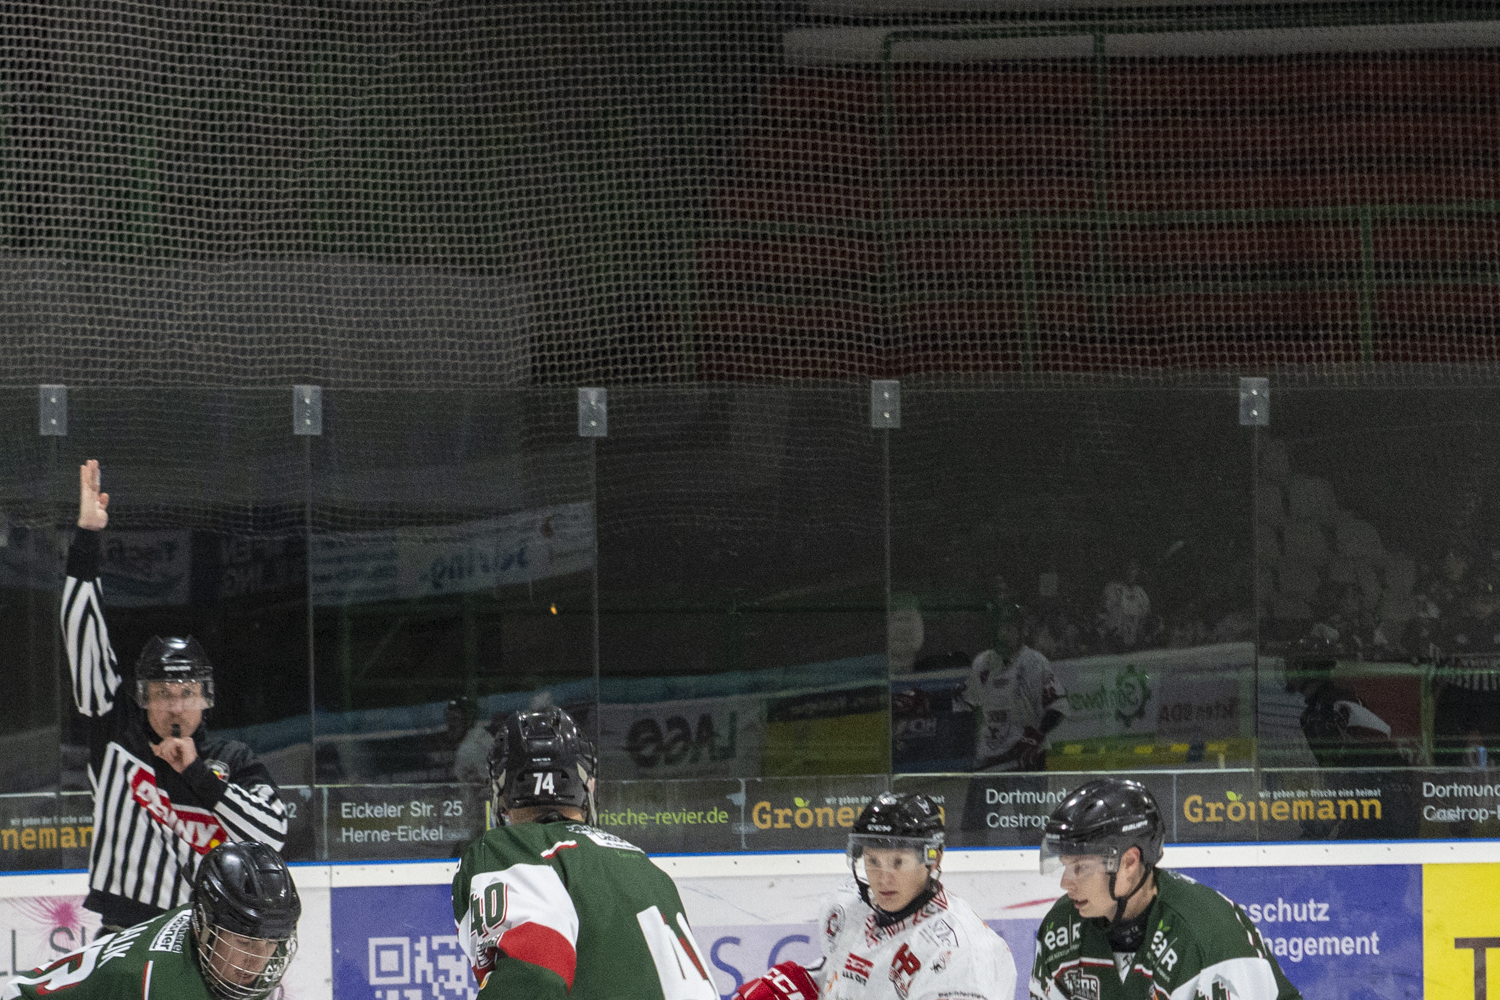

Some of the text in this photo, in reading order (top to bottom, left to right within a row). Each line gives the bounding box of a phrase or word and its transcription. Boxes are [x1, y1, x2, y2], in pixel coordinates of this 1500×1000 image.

[533, 772, 555, 796] 74
[986, 788, 1068, 805] Dortmund
[340, 800, 463, 819] Eickeler Str. 25
[599, 806, 729, 829] rische-revier.de
[986, 812, 1049, 831] Castrop
[341, 825, 445, 843] Herne-Eickel
[470, 881, 508, 938] 40
[1265, 930, 1380, 963] nagement
